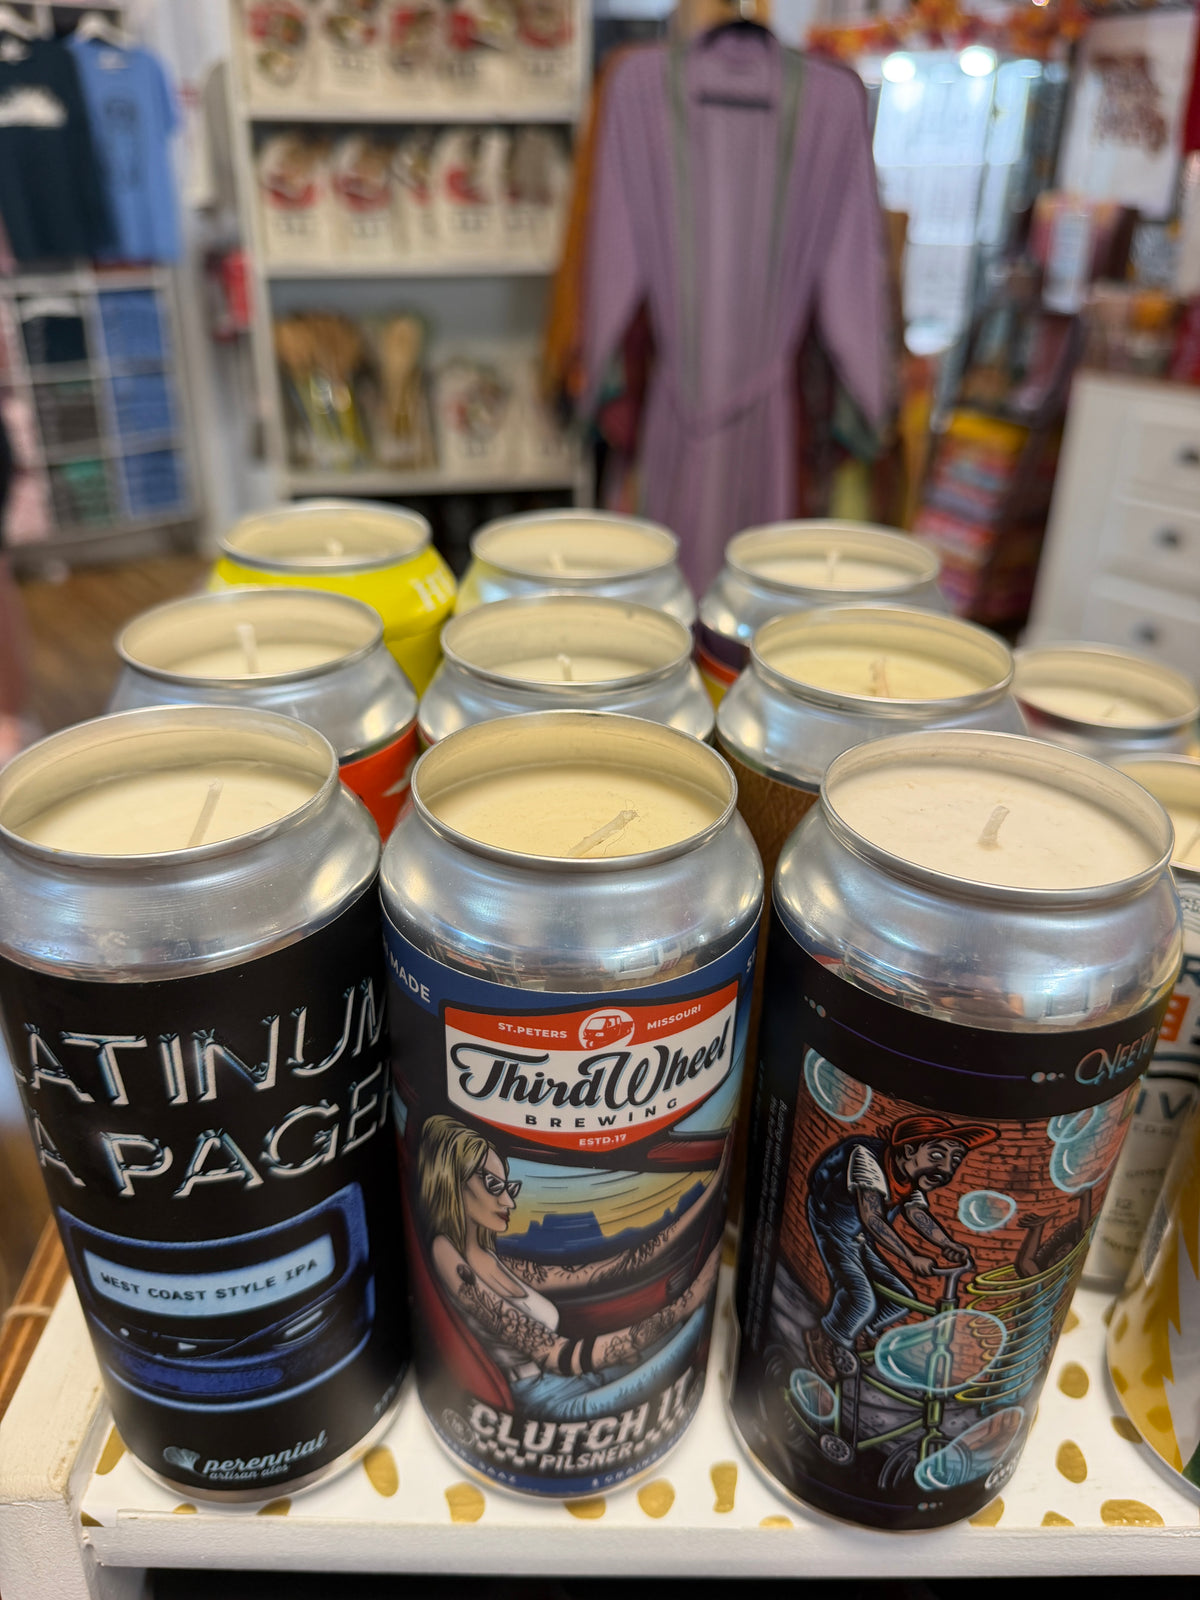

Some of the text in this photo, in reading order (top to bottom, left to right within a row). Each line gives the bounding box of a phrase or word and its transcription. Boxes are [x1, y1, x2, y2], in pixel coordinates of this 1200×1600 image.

[389, 951, 431, 1004] MADE
[15, 976, 389, 1106] ATINUM
[497, 1004, 702, 1040] ST.PETERS MISSOURI
[525, 1097, 678, 1128] BREWING
[578, 1133, 628, 1147] ESTD.17
[100, 1258, 319, 1301] WEST COAST STYLE IPA
[469, 1400, 650, 1454] CLUTCH
[203, 1429, 329, 1475] perennial
[209, 1463, 290, 1480] artisan ales
[538, 1441, 635, 1471] PILSNER
